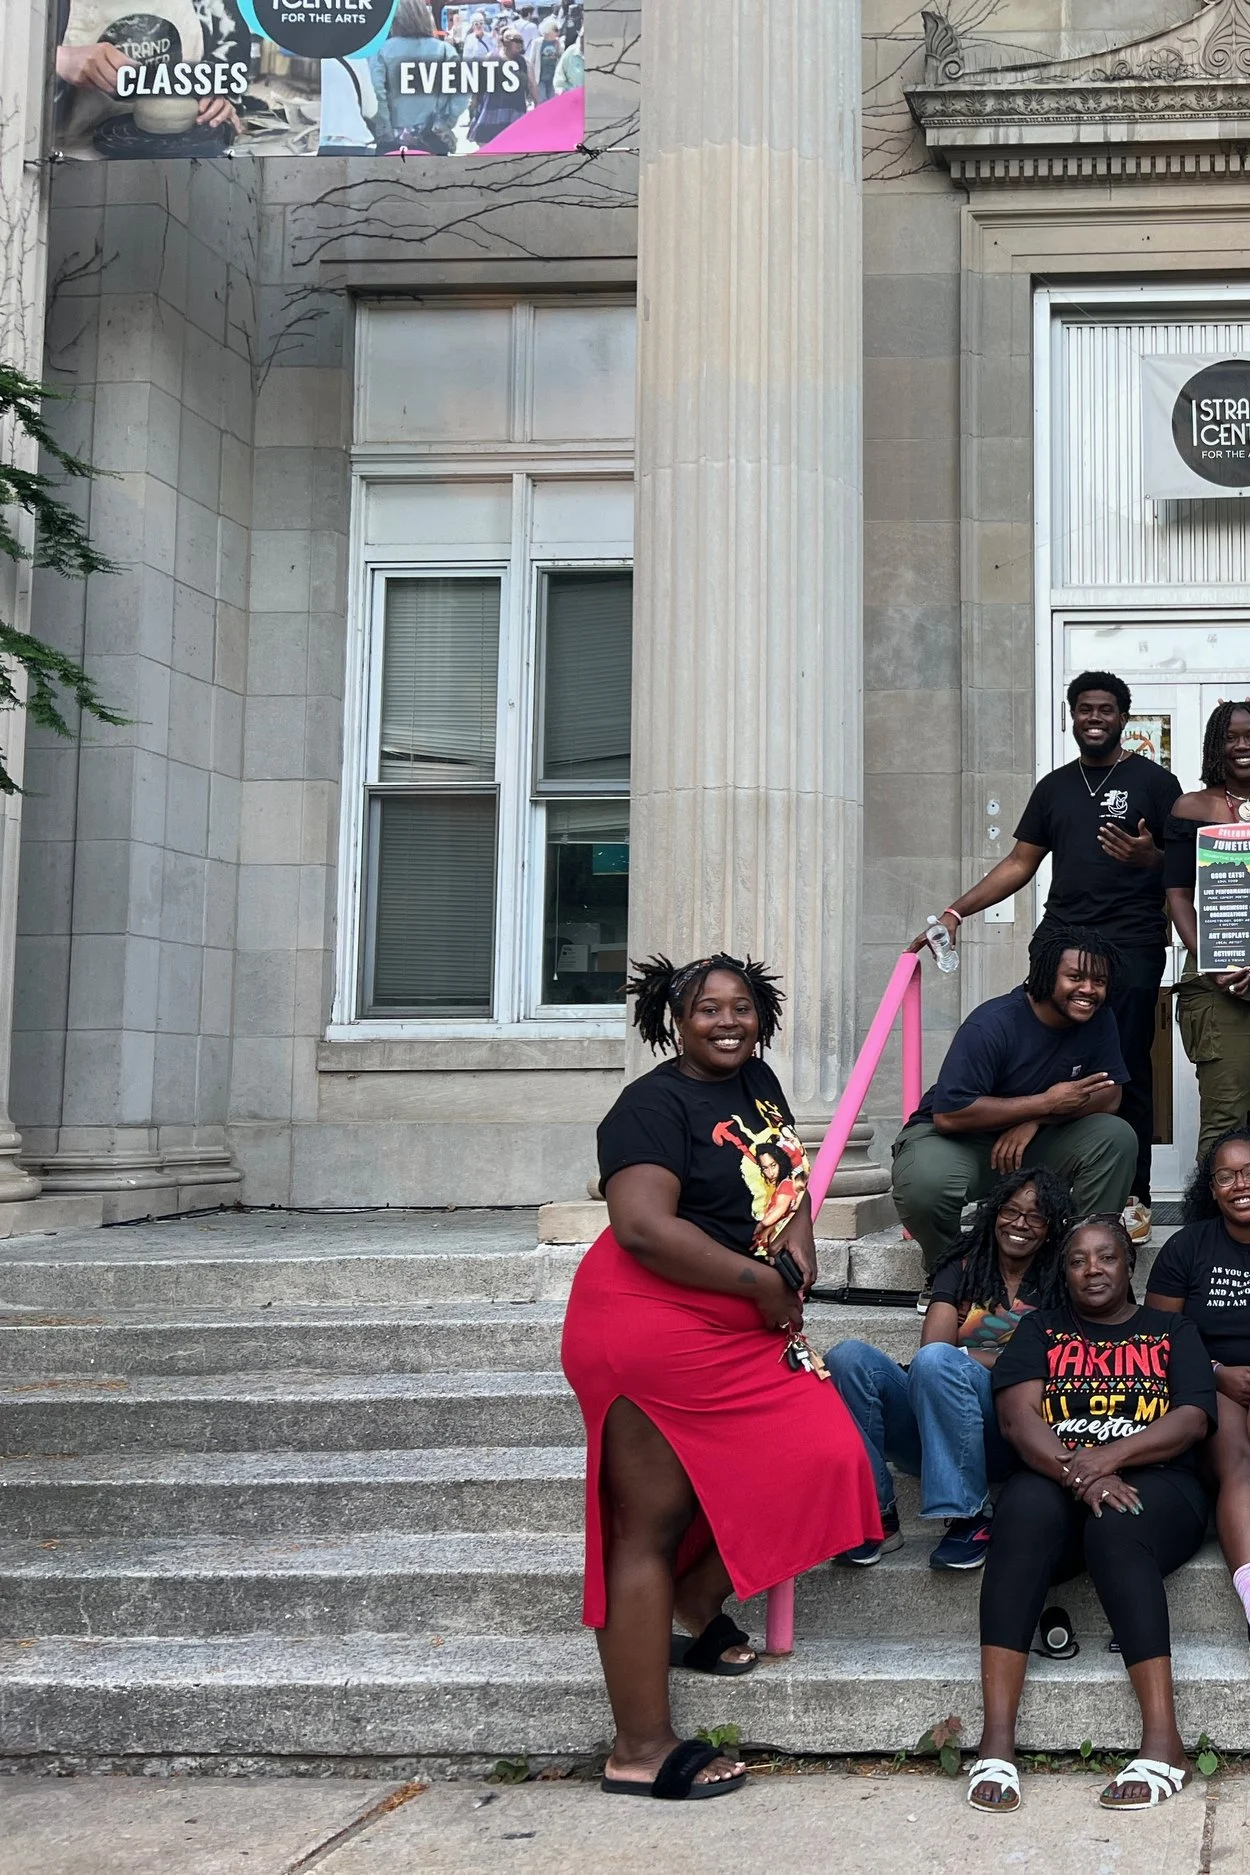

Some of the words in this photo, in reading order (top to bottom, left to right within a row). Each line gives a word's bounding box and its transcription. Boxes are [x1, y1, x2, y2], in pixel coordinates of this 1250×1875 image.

[281, 13, 305, 23] FOR
[309, 13, 332, 23] THE
[335, 14, 366, 23] ARTS
[116, 62, 248, 97] CLASSES
[400, 60, 520, 94] EVENTS
[1202, 450, 1223, 459] FOR
[1226, 450, 1245, 459] THE
[1228, 871, 1245, 879] EATS!
[1221, 931, 1250, 939] DISPLAYS
[1211, 1266, 1223, 1274] AS
[1224, 1268, 1242, 1277] YOU
[1210, 1277, 1215, 1285] I
[1208, 1288, 1227, 1296] AND
[1206, 1299, 1225, 1307] AND
[1232, 1299, 1247, 1307] AM
[1089, 1394, 1126, 1416] OF
